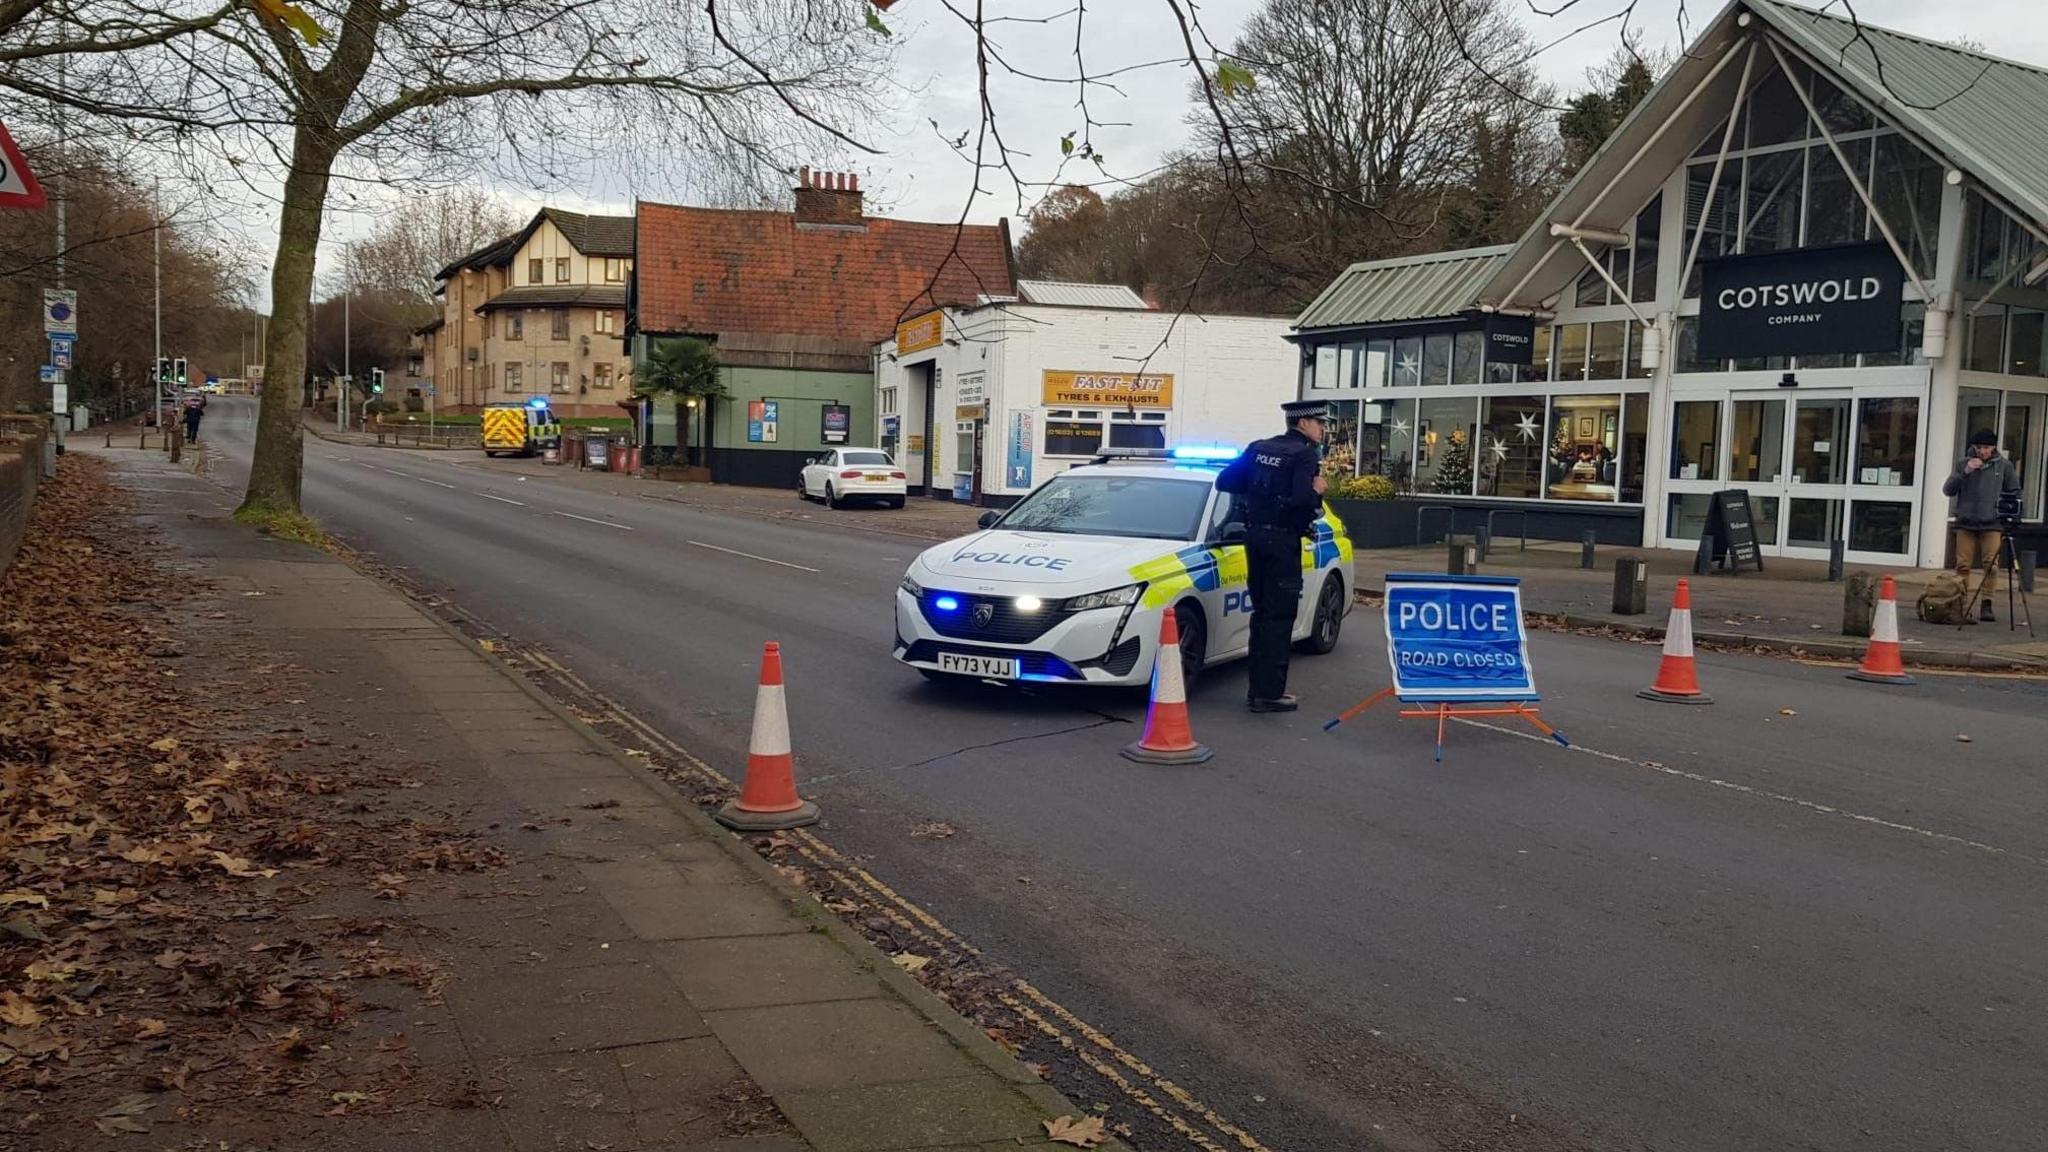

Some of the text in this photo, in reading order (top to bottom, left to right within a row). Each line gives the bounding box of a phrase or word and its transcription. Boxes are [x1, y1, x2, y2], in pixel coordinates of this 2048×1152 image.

[1719, 277, 1880, 310] COTSWOLD
[1768, 313, 1822, 325] COMPANY
[1492, 333, 1529, 344] COTSWOLD
[1056, 392, 1160, 404] TYRES & EXHAUSTS
[1255, 453, 1283, 468] POLICE
[952, 551, 1073, 571] POLICE
[1399, 601, 1509, 632] POLICE
[943, 655, 1012, 677] FY73 YJJ
[1401, 651, 1516, 668] ROAD CLOSED
